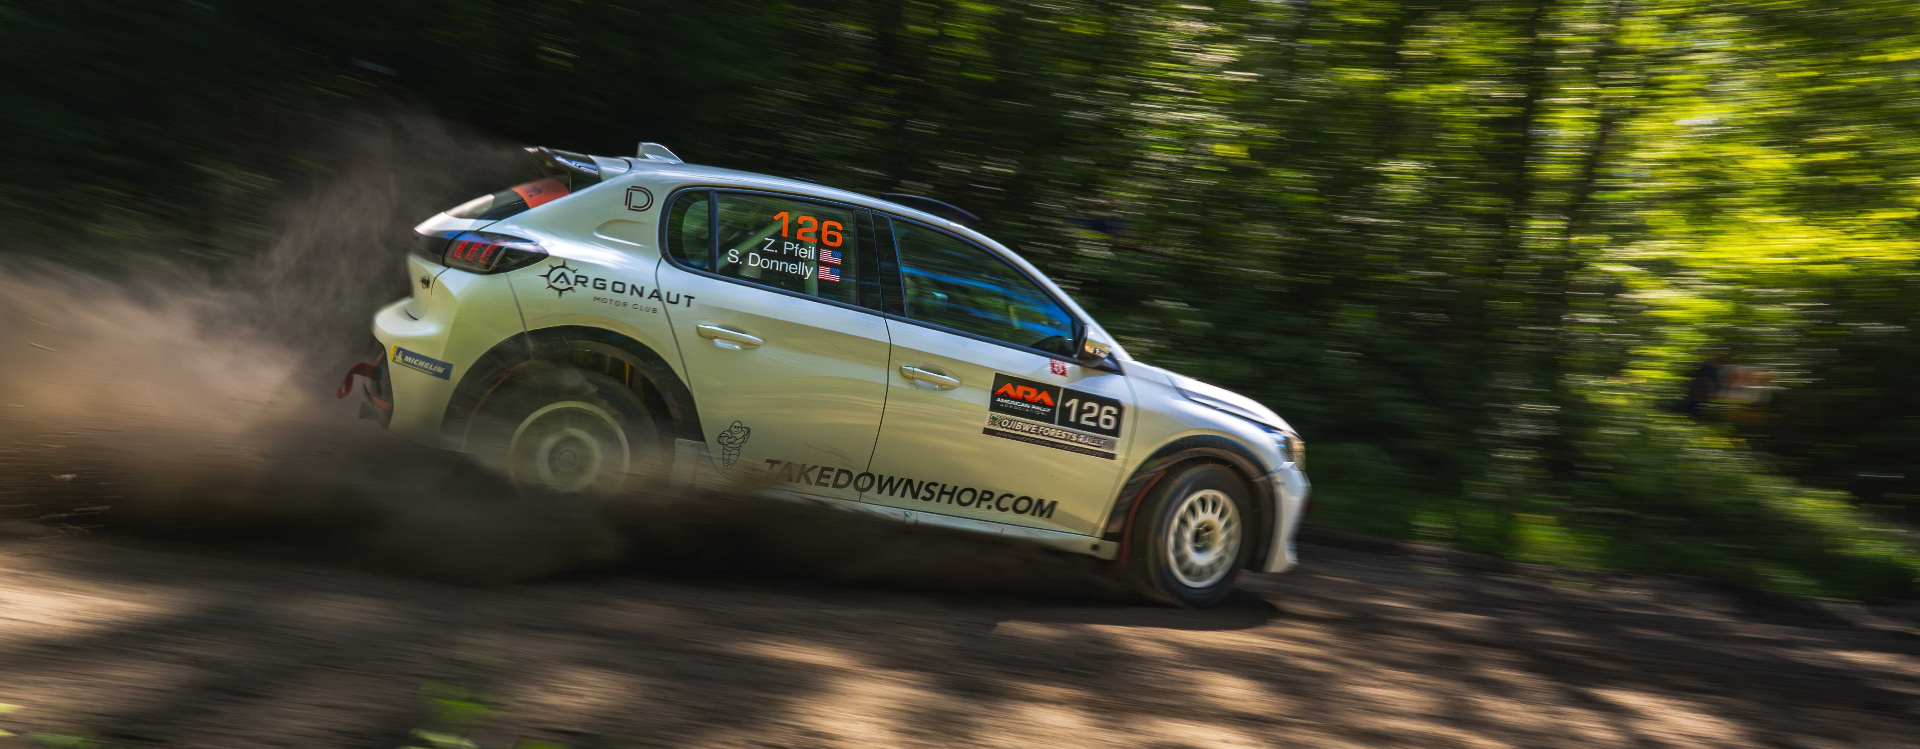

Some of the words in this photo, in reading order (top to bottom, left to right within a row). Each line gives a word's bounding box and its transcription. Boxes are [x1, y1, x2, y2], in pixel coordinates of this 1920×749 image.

[773, 211, 843, 247] 126
[763, 237, 778, 253] Z.
[783, 241, 815, 260] Pfeil
[727, 249, 743, 265] S.
[748, 253, 814, 280] Donnelly
[550, 271, 696, 308] ARGONAUT
[592, 296, 629, 308] MOTOR
[631, 303, 658, 314] CLUB
[404, 355, 446, 374] MICHELIN
[995, 382, 1055, 407] ARA
[996, 397, 1031, 409] AMERICAN
[1064, 398, 1119, 430] 126
[1001, 419, 1038, 434] OJIBWE
[1038, 424, 1077, 442] FORESTS
[764, 458, 1058, 519] TAKEDOWNSHOP.COM
